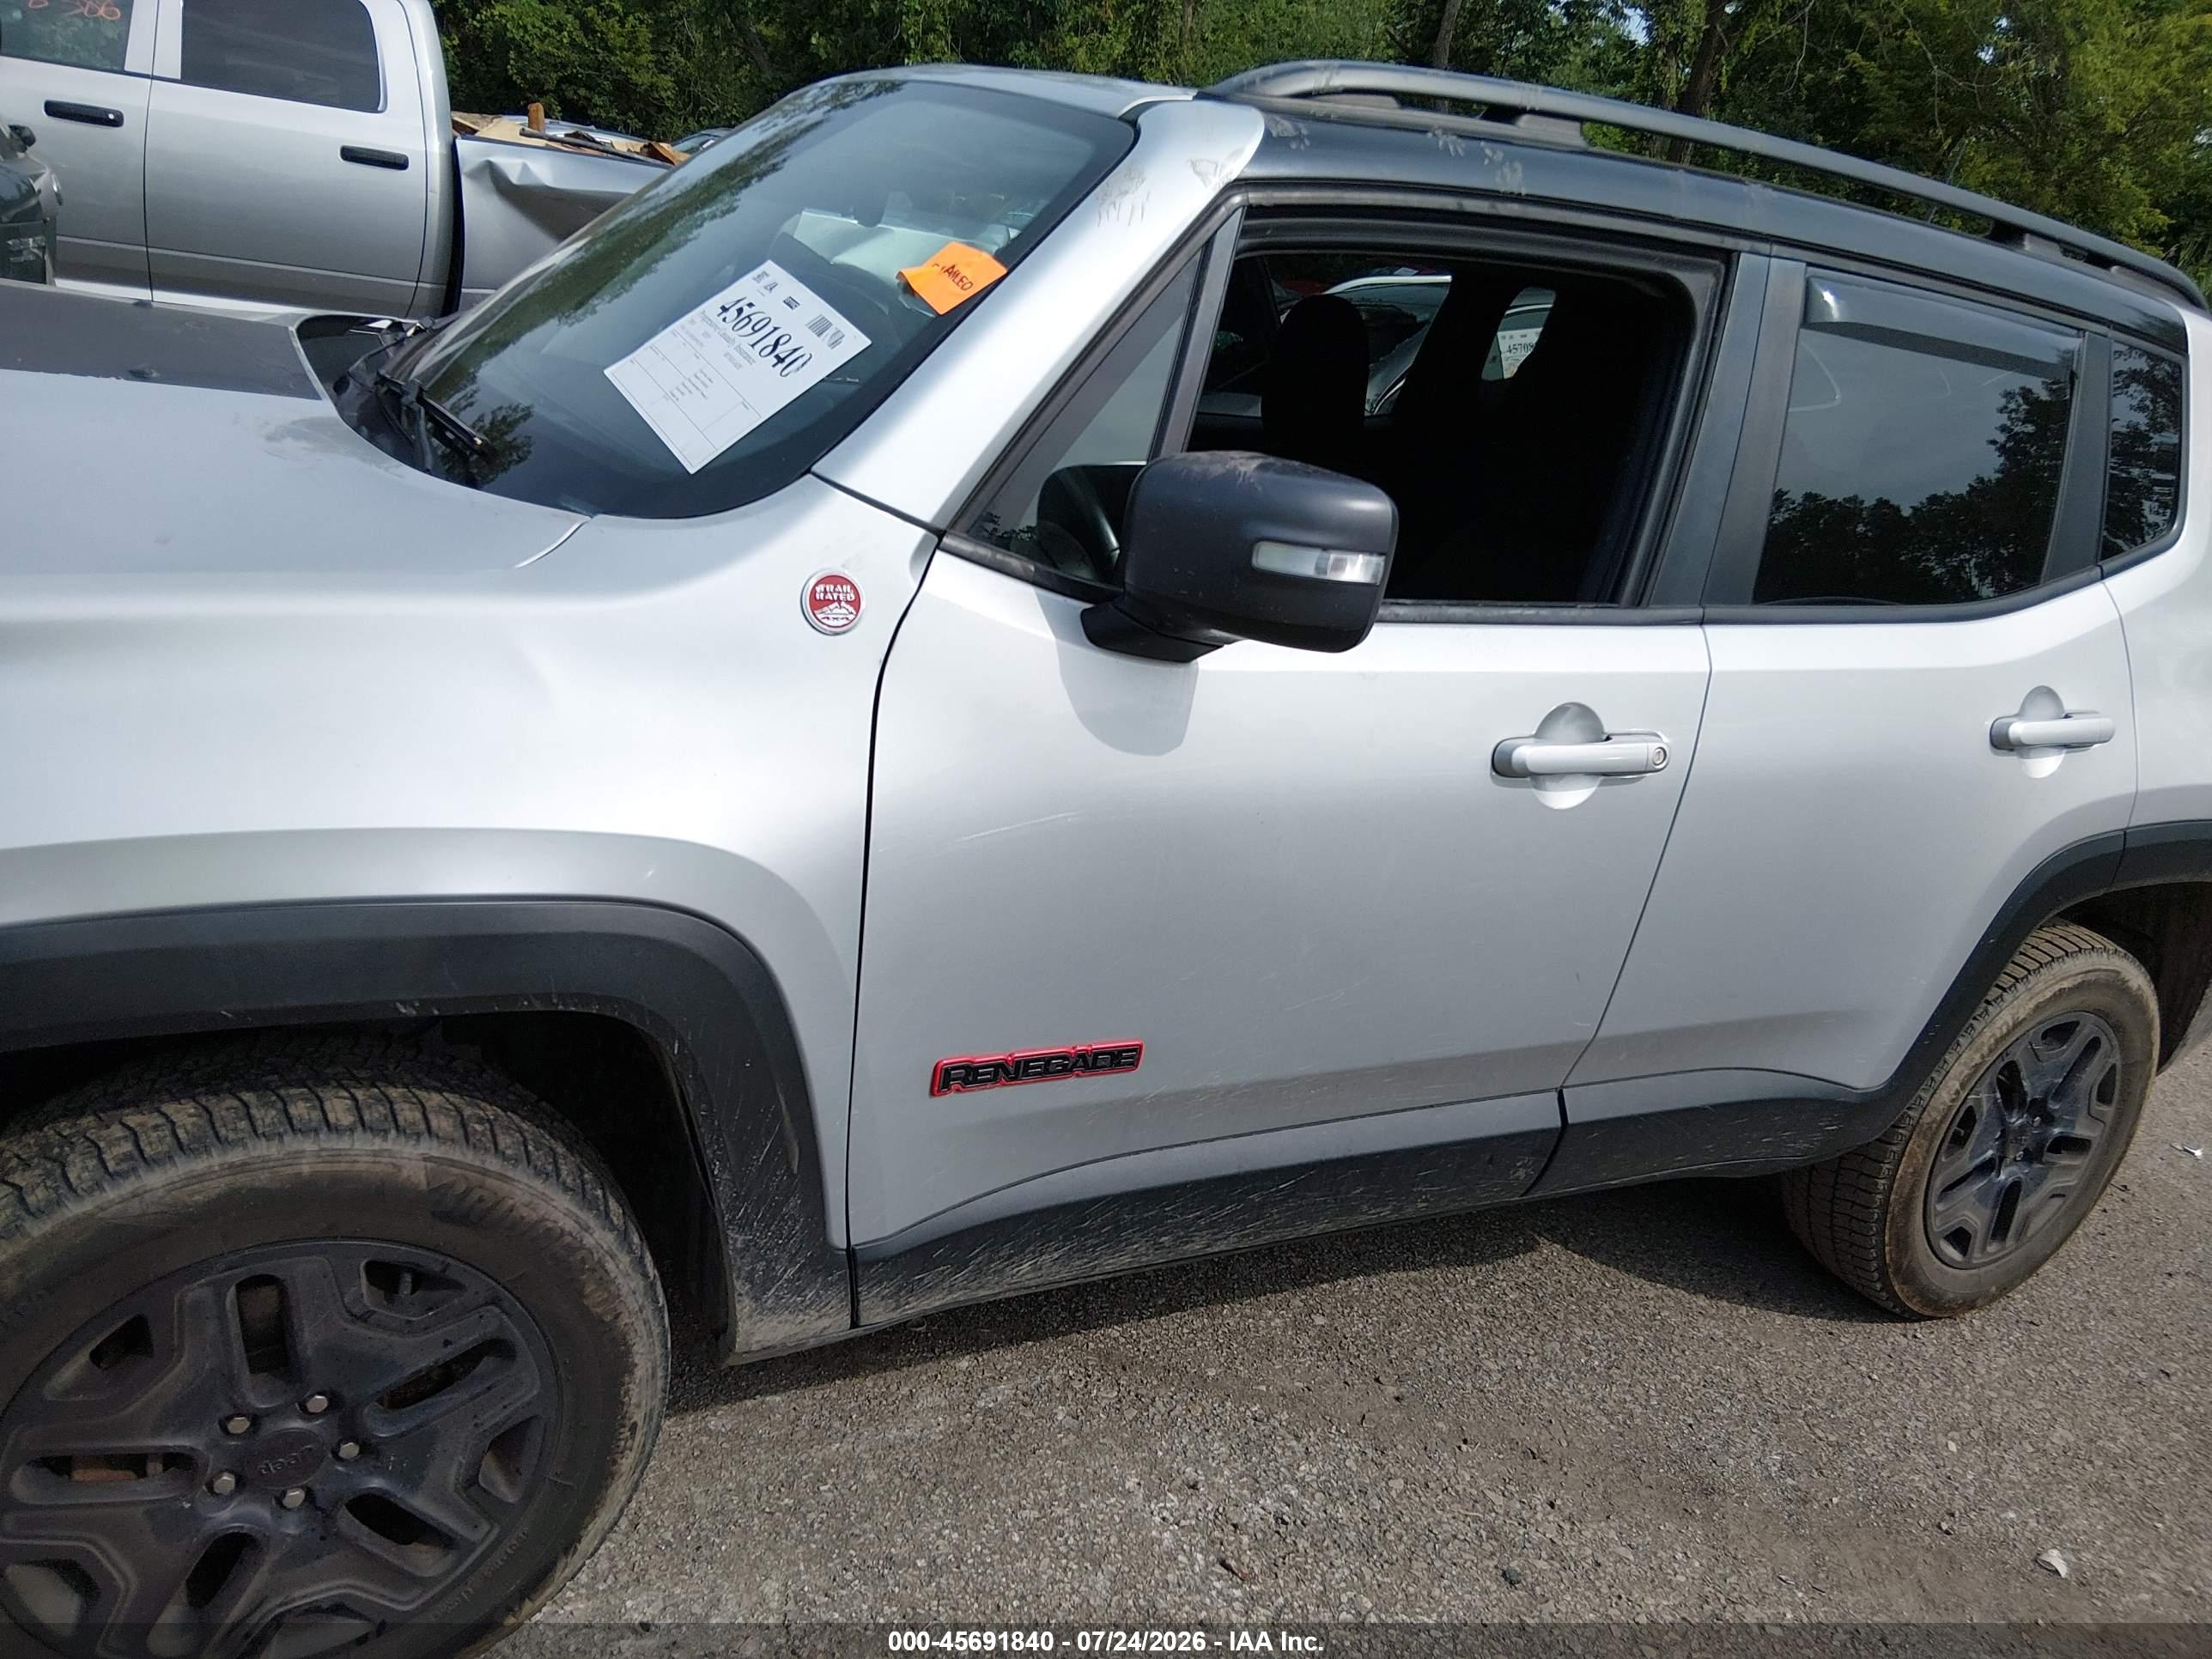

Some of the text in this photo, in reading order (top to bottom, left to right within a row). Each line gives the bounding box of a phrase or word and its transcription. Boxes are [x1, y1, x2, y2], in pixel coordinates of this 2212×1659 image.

[717, 297, 812, 377] 45691840
[815, 592, 855, 601] RATED
[816, 584, 854, 592] TRAIL
[938, 1044, 1142, 1093] RENEGADE
